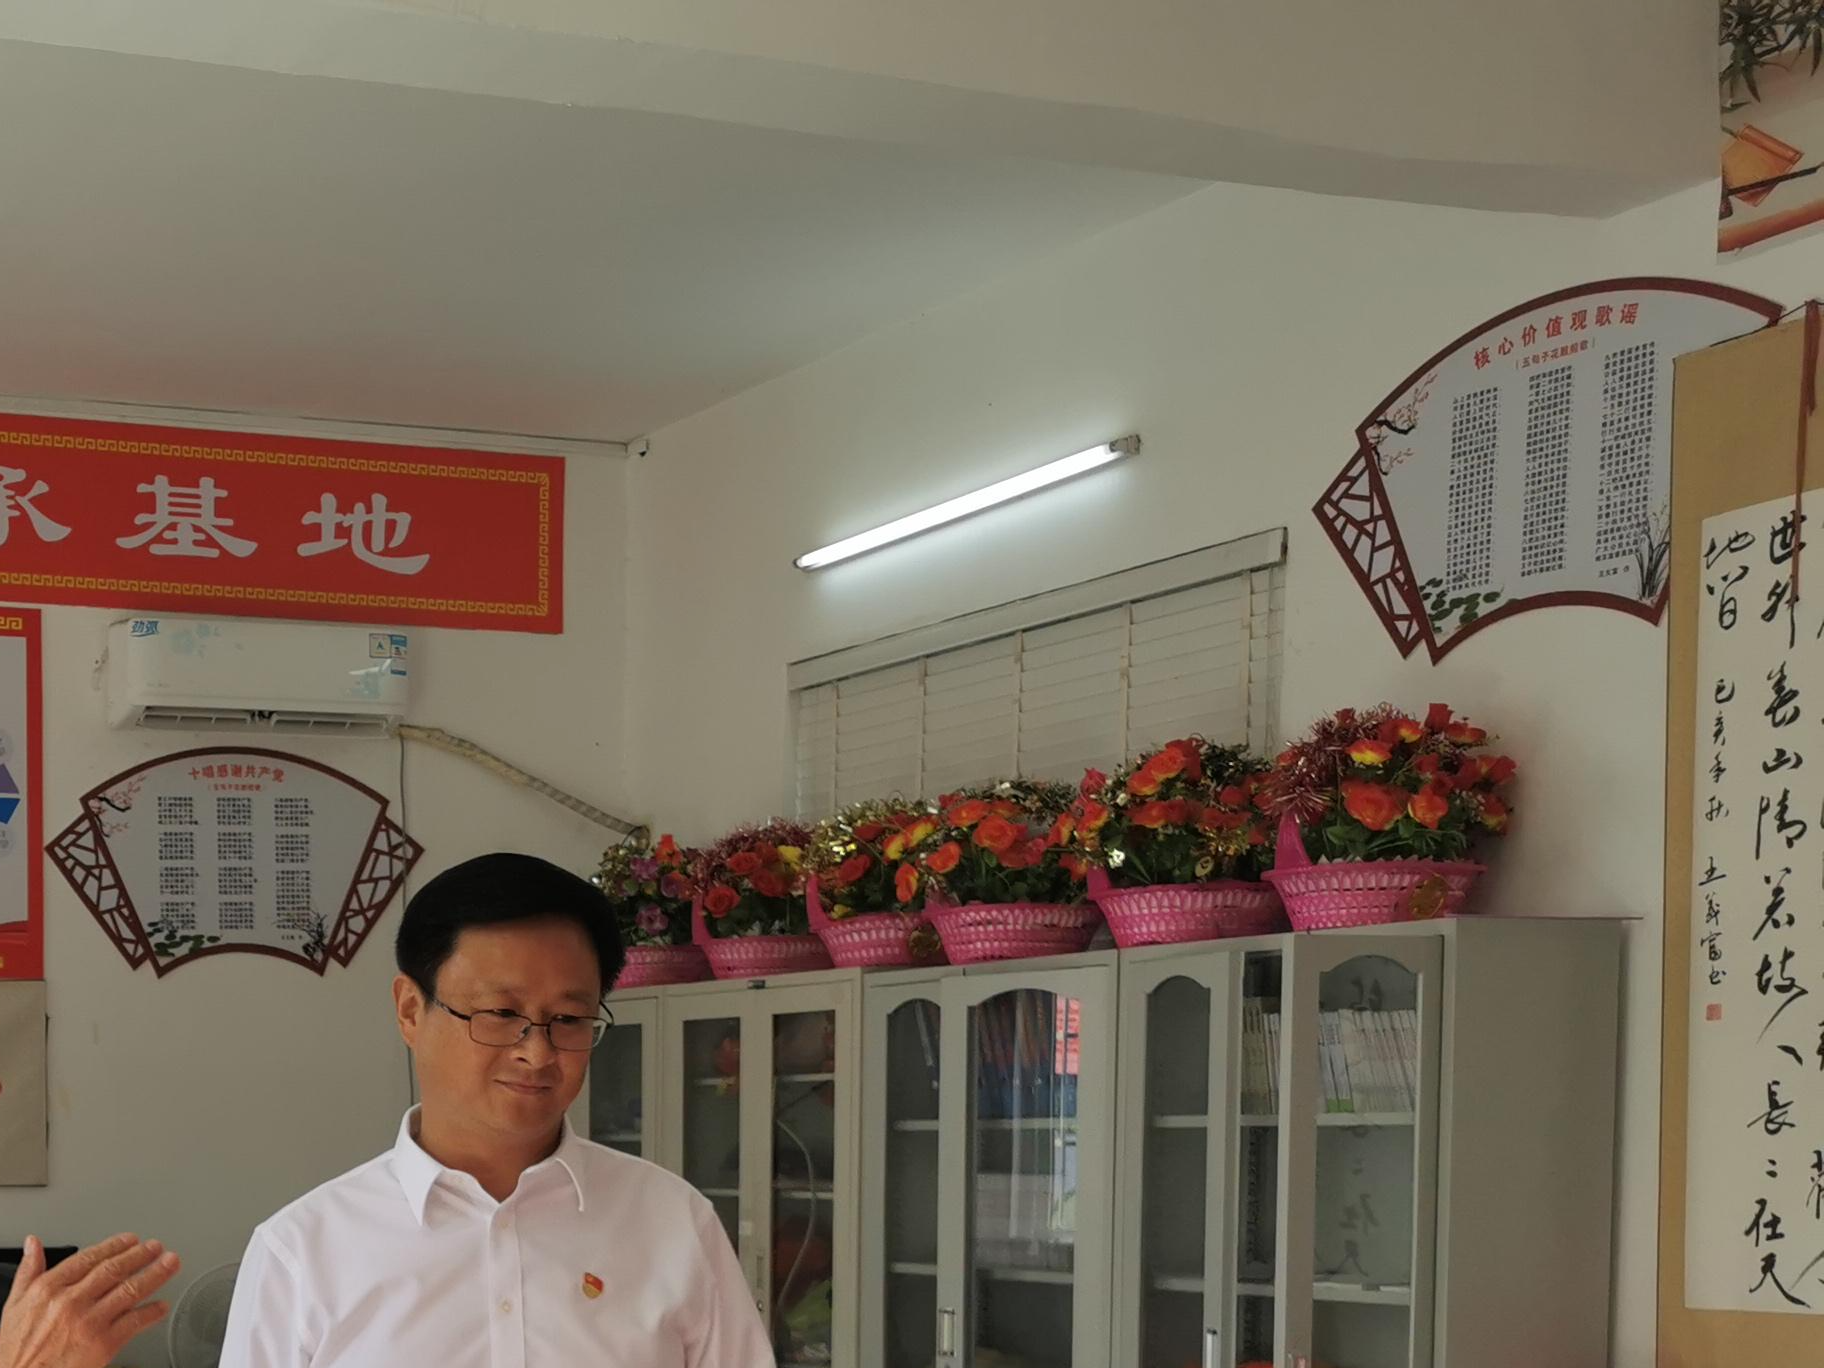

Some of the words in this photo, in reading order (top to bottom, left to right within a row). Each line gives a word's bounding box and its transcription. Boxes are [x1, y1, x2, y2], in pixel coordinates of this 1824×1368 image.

[1473, 303, 1640, 370] 核心价值观歌谣
[188, 764, 286, 783] 十唱感谢共产党
